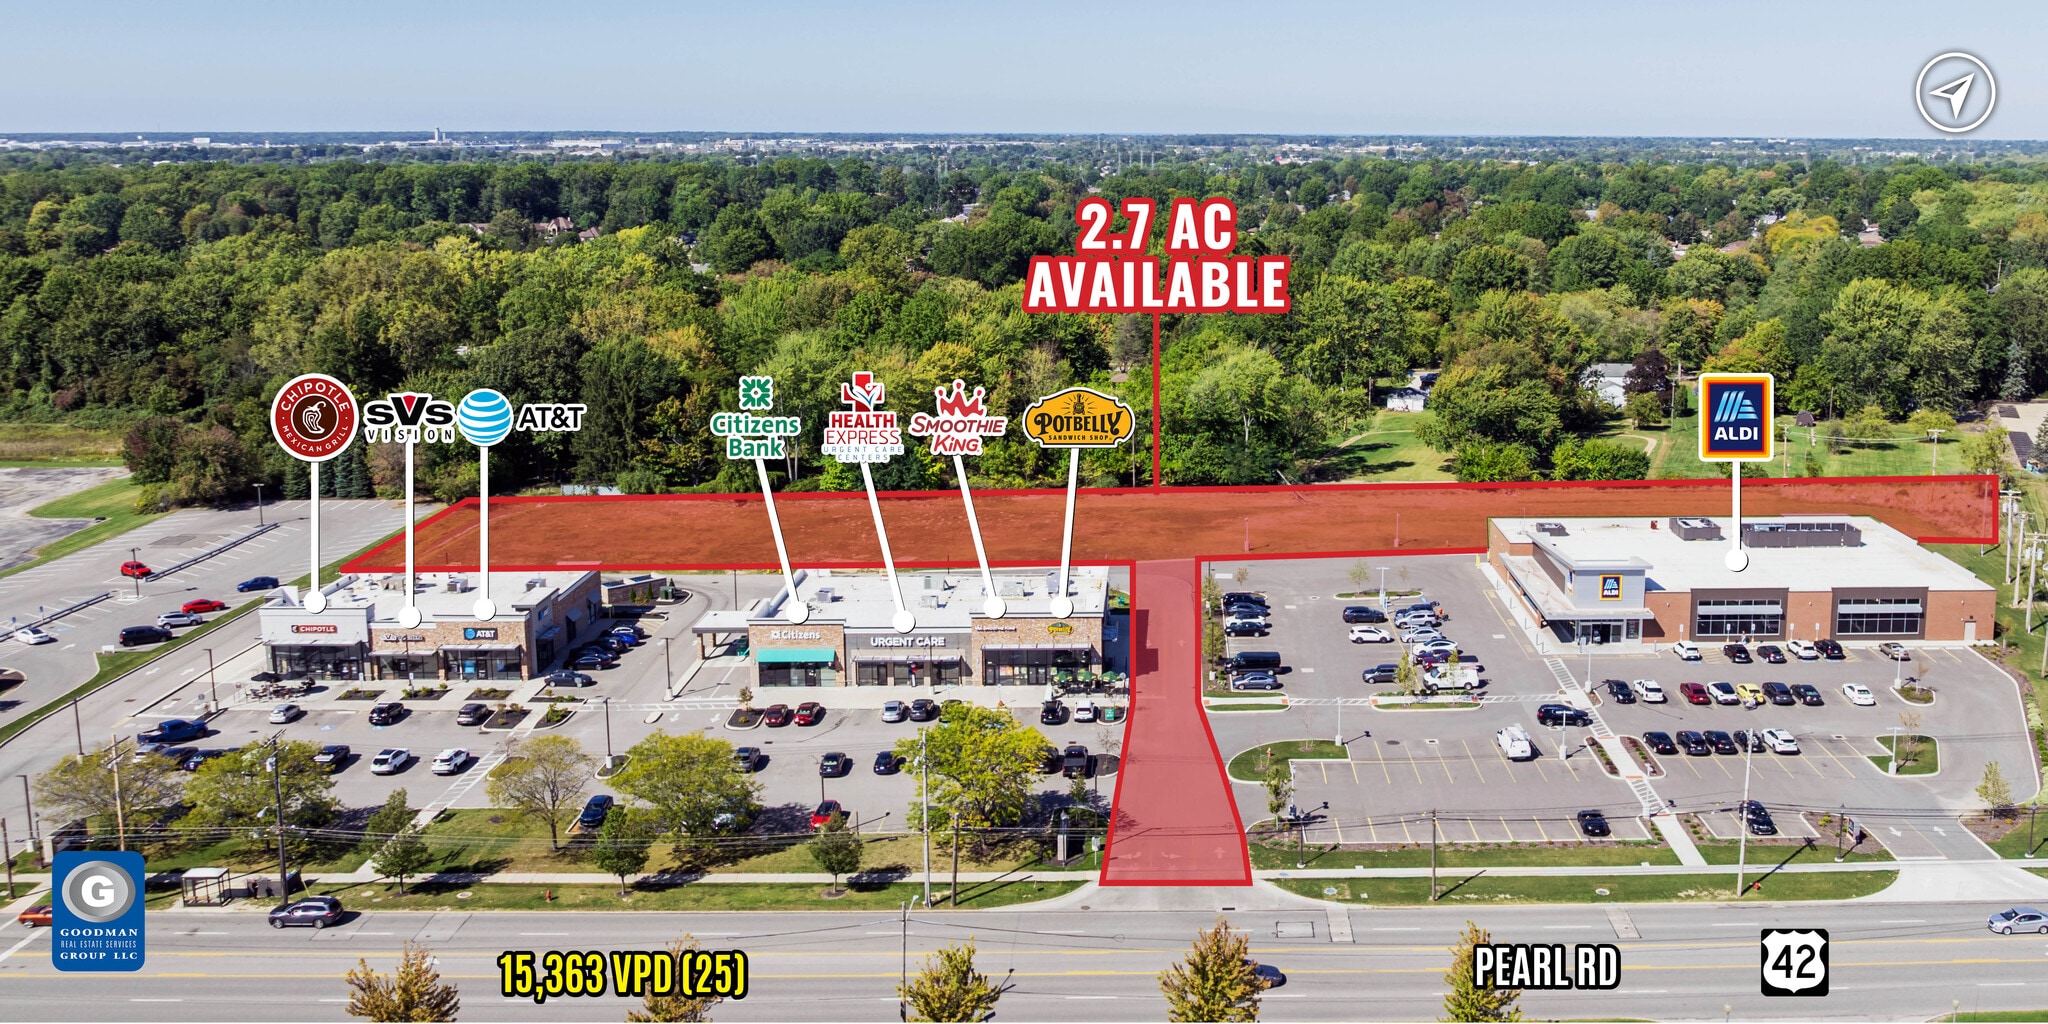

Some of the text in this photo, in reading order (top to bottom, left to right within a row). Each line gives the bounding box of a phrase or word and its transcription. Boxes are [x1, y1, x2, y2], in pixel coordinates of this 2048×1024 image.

[476, 630, 495, 638] AT&T
[782, 631, 821, 640] Citizens
[870, 637, 946, 647] URGENT CARE
